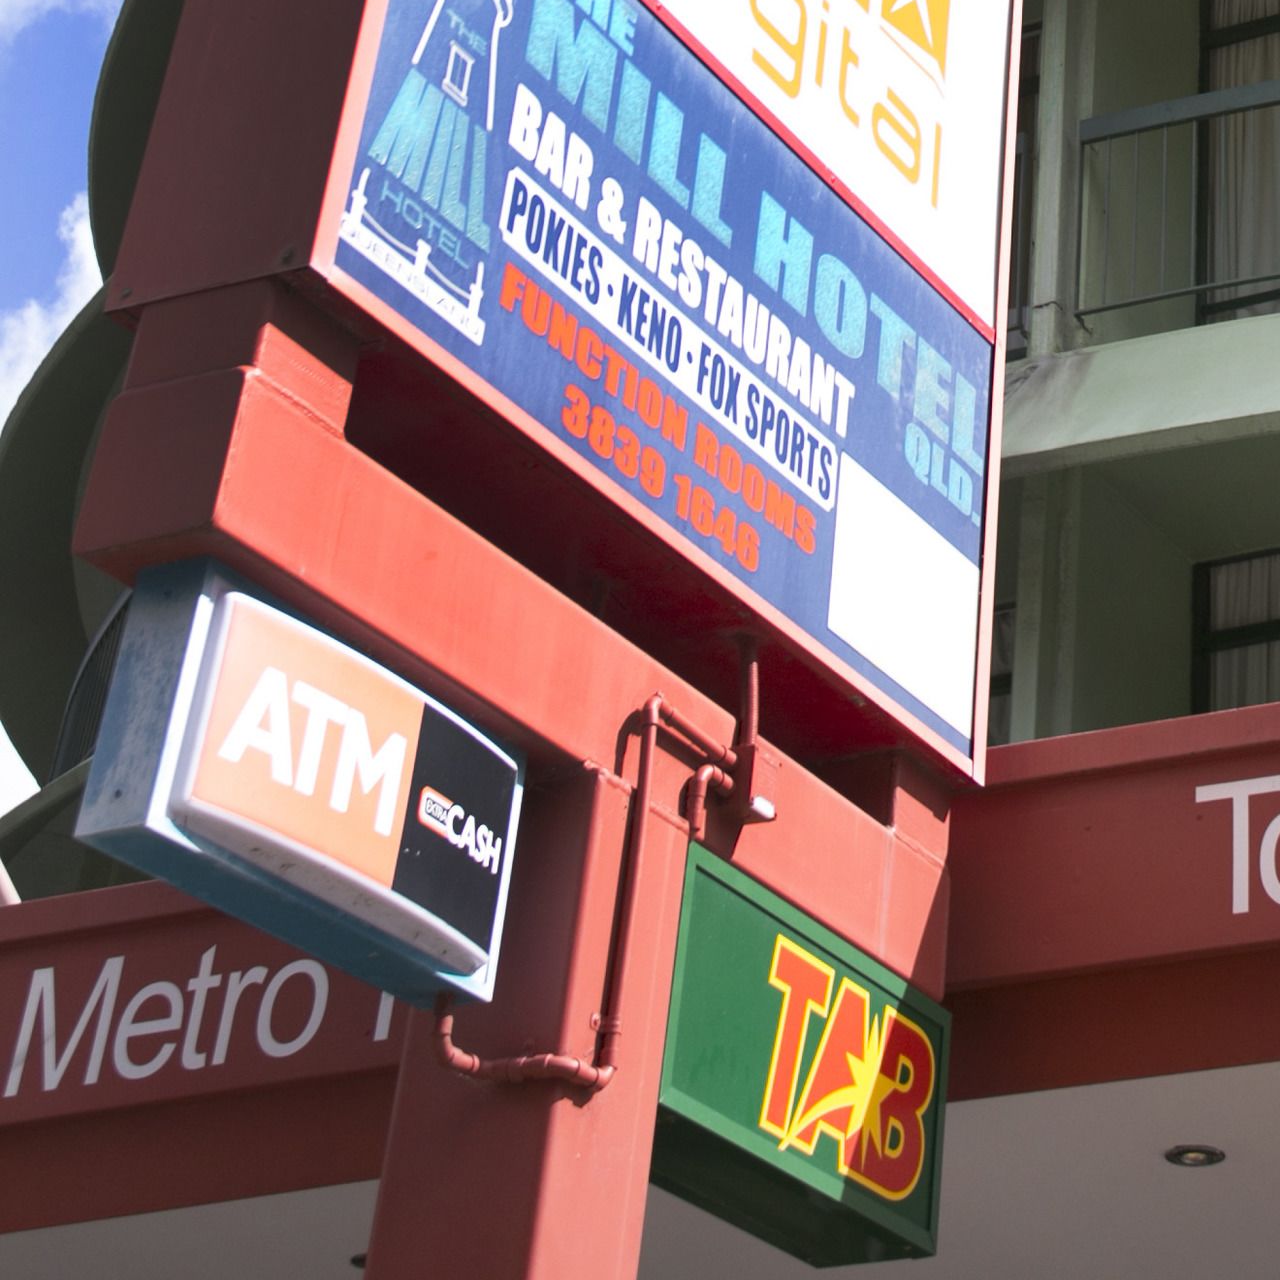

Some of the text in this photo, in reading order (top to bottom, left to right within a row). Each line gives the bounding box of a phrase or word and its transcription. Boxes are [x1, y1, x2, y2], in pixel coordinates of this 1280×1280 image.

[447, 8, 488, 56] THE
[368, 67, 490, 253] MILL
[380, 180, 469, 270] HOTEL
[507, 177, 832, 501] POKIES KENO FOX SPORTS
[508, 83, 855, 438] BAR & RESTAURANT
[753, 190, 983, 477] HOTEL
[500, 262, 817, 555] FUNCTION ROOMS
[560, 383, 760, 574] 3839 1646
[905, 423, 980, 527] QLD.
[217, 665, 408, 838] ATM
[446, 804, 502, 874] CASH
[3, 944, 330, 1097] Metro
[759, 933, 935, 1201] TAB
